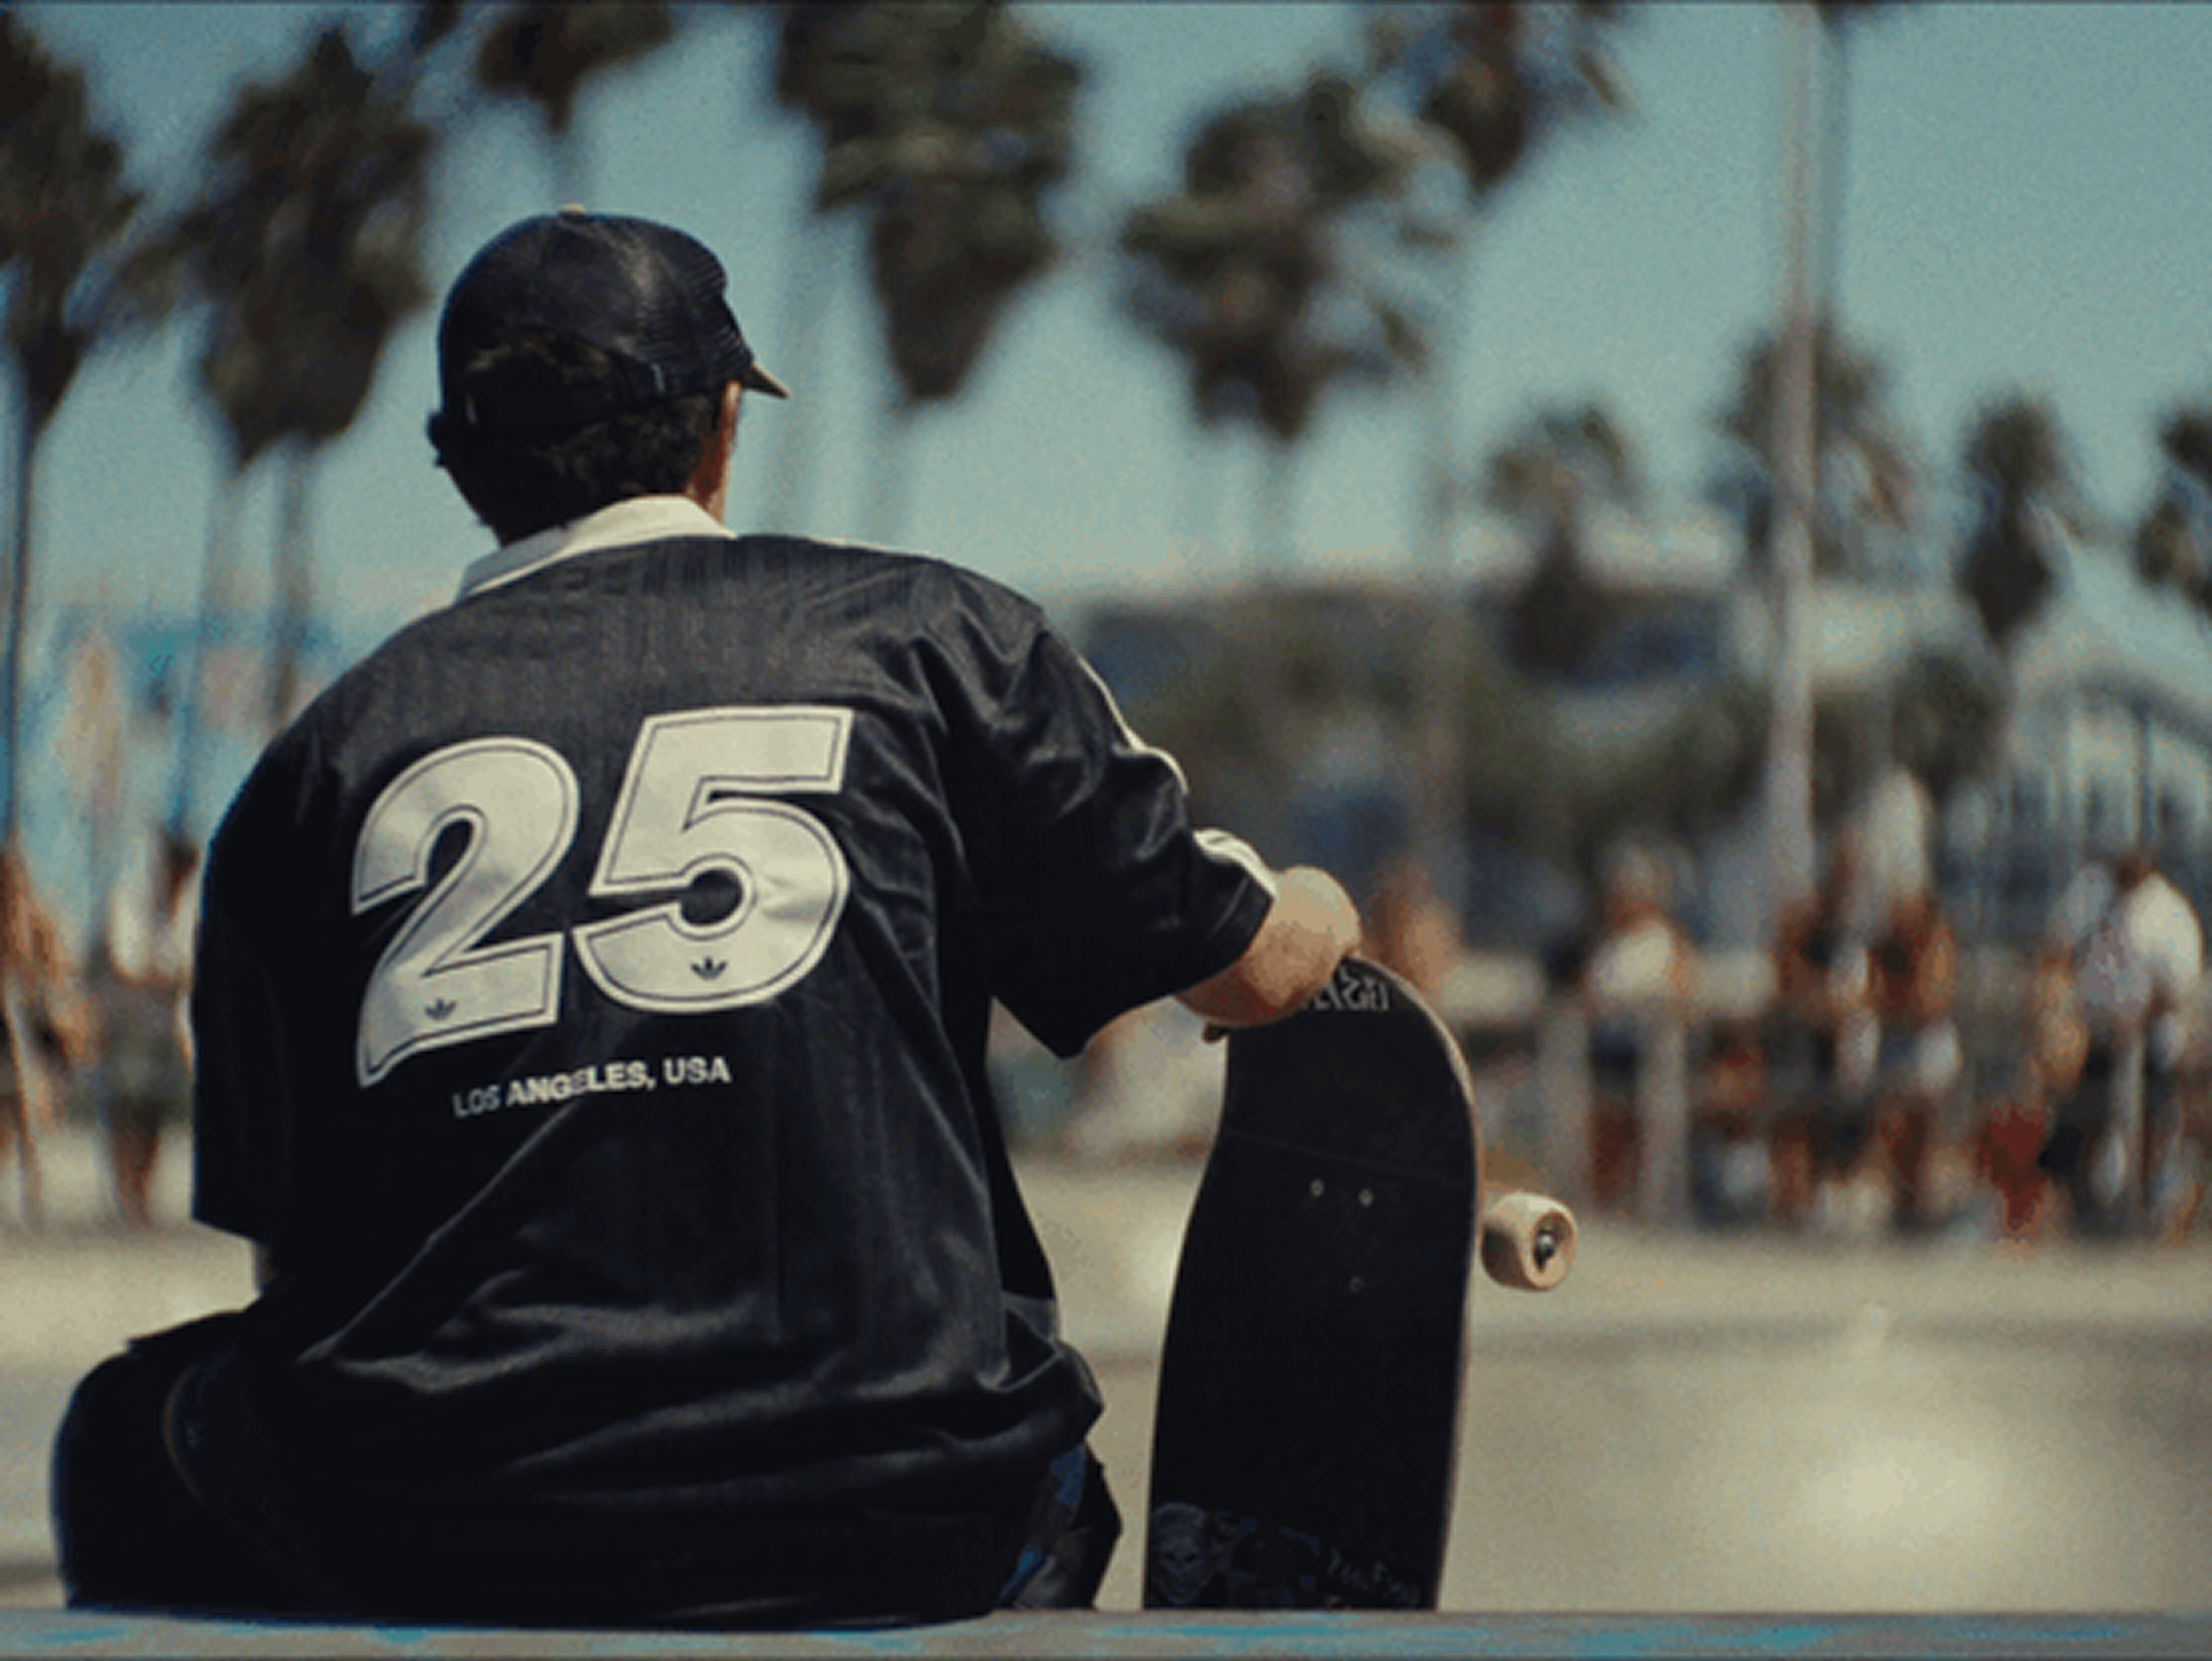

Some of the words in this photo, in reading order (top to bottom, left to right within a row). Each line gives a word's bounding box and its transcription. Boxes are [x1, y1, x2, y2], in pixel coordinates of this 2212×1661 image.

[352, 704, 854, 1088] 25
[452, 1084, 502, 1118] LOS
[506, 1061, 657, 1106] ANGELES,
[664, 1056, 732, 1085] USA
